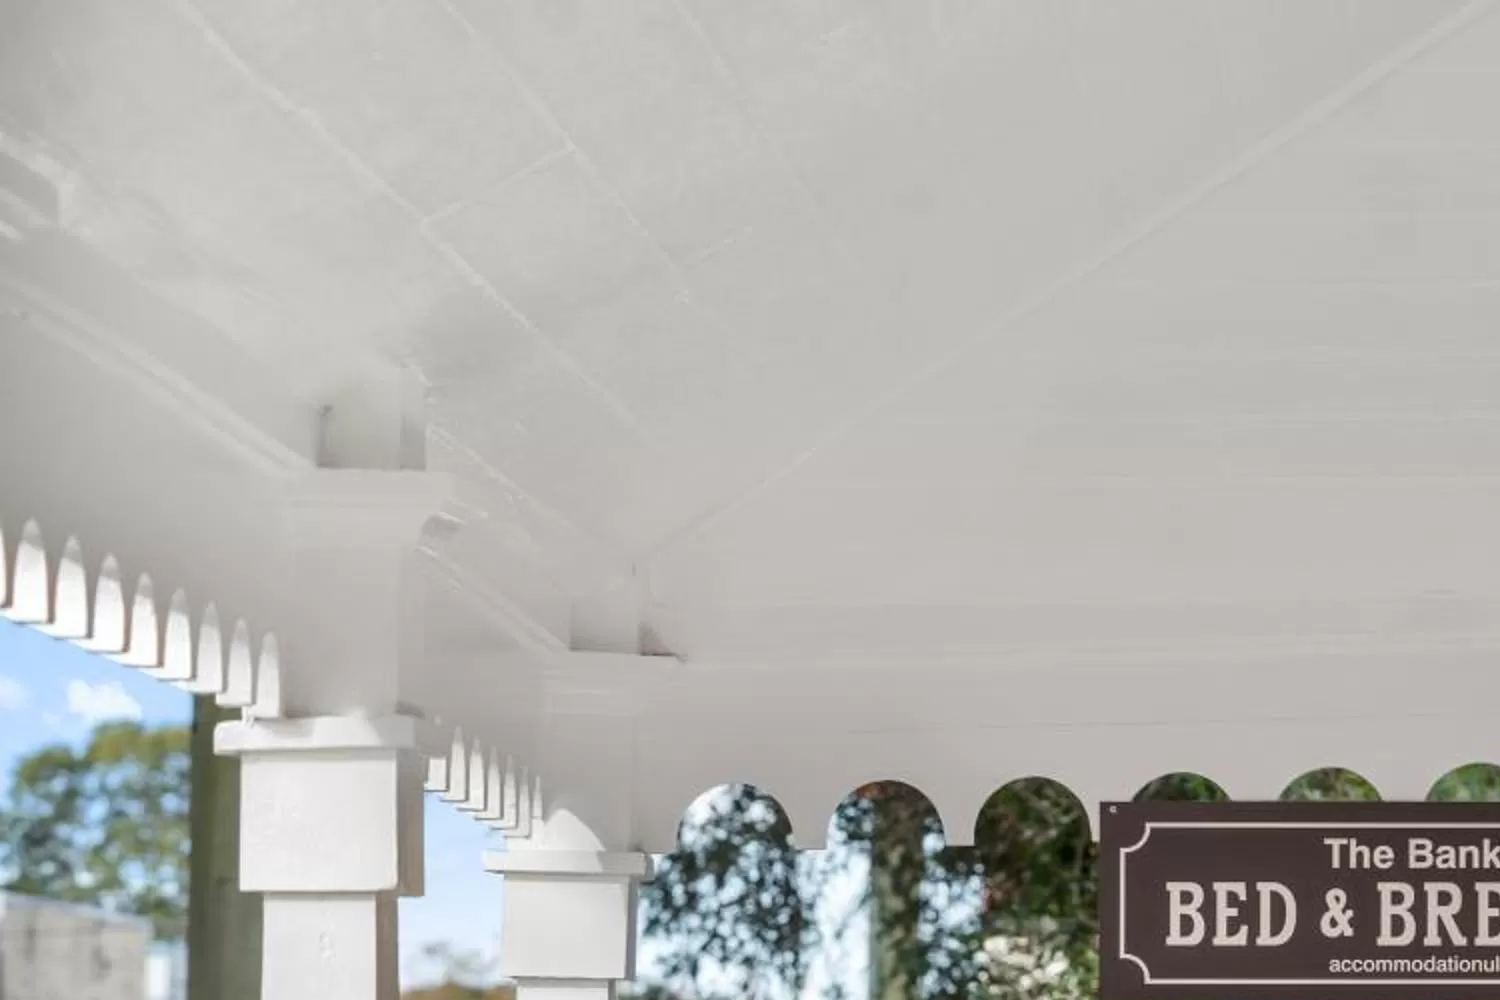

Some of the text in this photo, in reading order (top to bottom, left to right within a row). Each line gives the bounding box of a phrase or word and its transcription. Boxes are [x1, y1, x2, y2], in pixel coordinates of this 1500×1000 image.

[1323, 838, 1394, 869] The
[1164, 881, 1297, 947] BED
[1319, 887, 1355, 938] &
